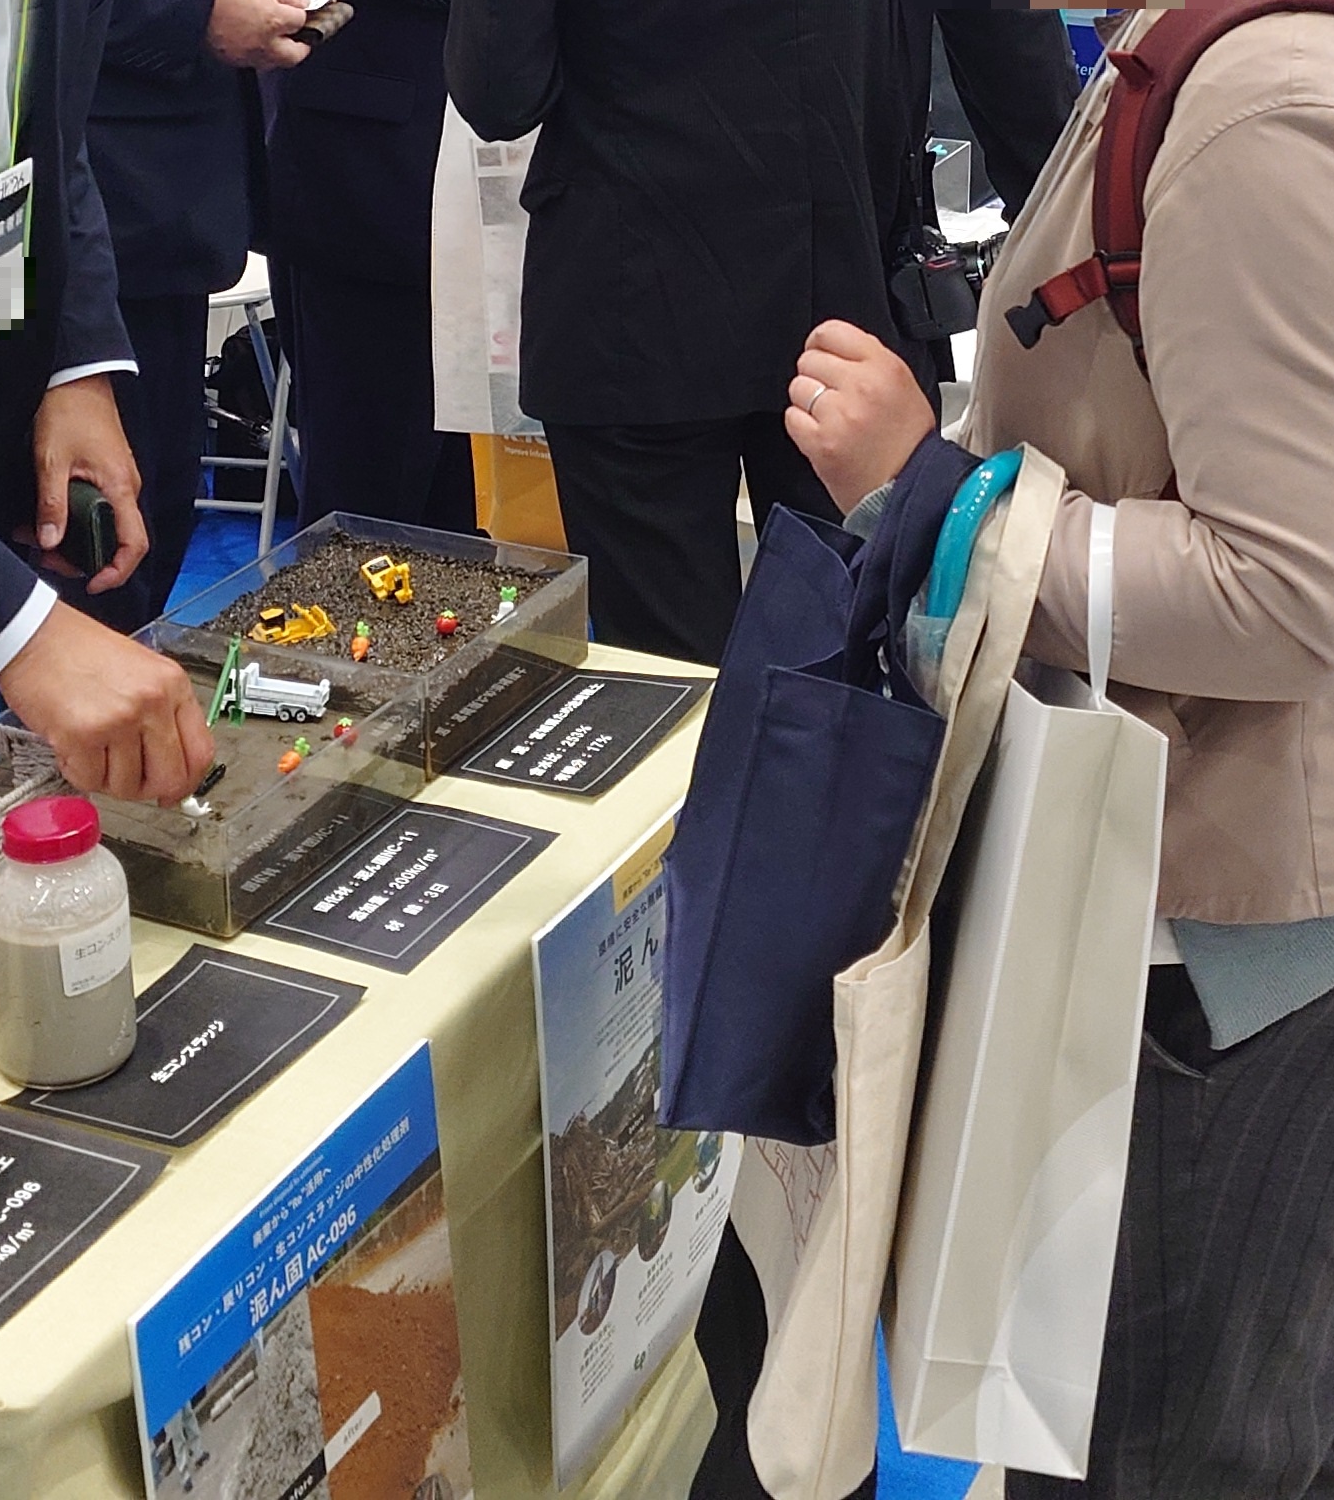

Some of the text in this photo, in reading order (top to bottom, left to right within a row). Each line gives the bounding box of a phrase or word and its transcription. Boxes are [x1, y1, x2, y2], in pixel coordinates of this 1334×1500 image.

[150, 1020, 225, 1084] 生コンスラッジ
[249, 1203, 357, 1328] 泥ん固 AC-096
